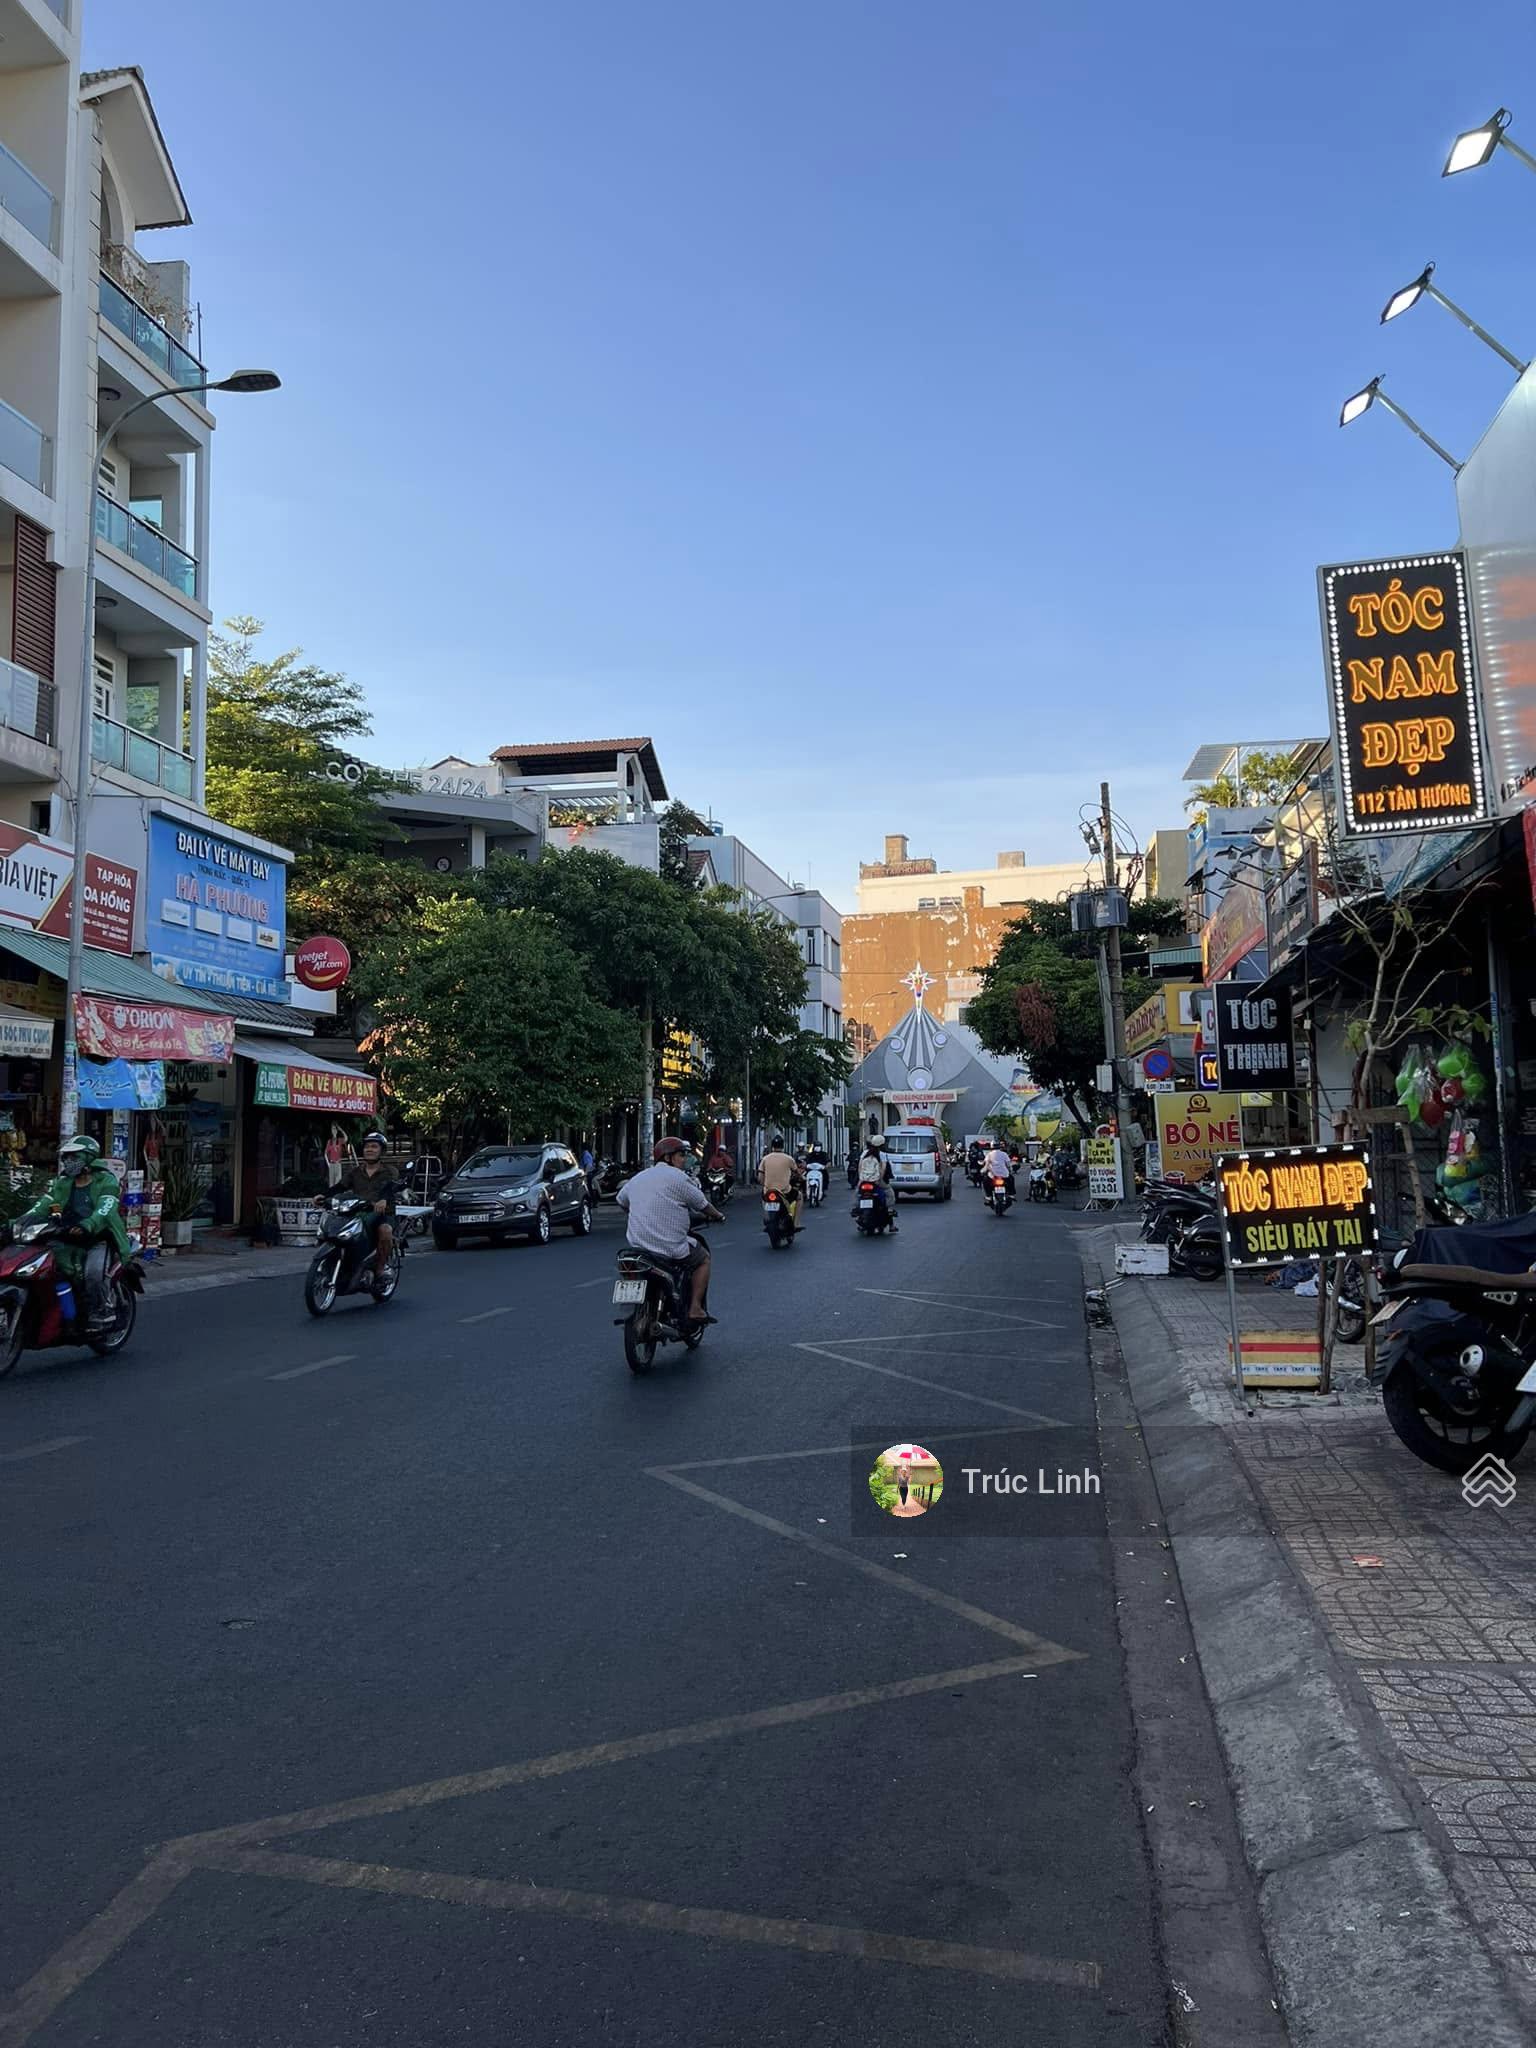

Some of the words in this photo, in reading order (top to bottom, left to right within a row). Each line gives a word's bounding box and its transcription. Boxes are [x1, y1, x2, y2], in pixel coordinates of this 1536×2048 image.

[1349, 579, 1444, 637] TÓC
[1348, 650, 1459, 703] NAM
[1361, 716, 1455, 776] ĐẸP
[429, 774, 488, 798] 24/24
[1357, 791, 1386, 814] 112
[1388, 786, 1418, 811] TÂN
[1420, 783, 1471, 809] HƯƠNG
[177, 831, 196, 859] ĐẠI
[199, 837, 212, 860] LÝ
[229, 850, 251, 875] MÁY
[252, 859, 270, 881] BAY
[23, 863, 58, 901] VIỆT
[97, 866, 113, 884] TẠP
[114, 871, 132, 890] HÓA
[84, 885, 98, 904] OA
[100, 890, 130, 913] HỒNG
[1223, 1042, 1288, 1075] THỊNH
[293, 1069, 314, 1091] BÁN
[332, 1075, 354, 1096] MÁY
[356, 1081, 374, 1098] BAY
[1165, 1115, 1201, 1145] BÒ
[1207, 1114, 1240, 1144] NÉ
[1223, 1161, 1272, 1213] TÓC
[1272, 1163, 1324, 1210] NAM
[1323, 1160, 1368, 1211] ĐẸP
[1246, 1219, 1289, 1253] SIÊU
[1292, 1216, 1328, 1249] RÁY
[1333, 1218, 1363, 1246] TAI
